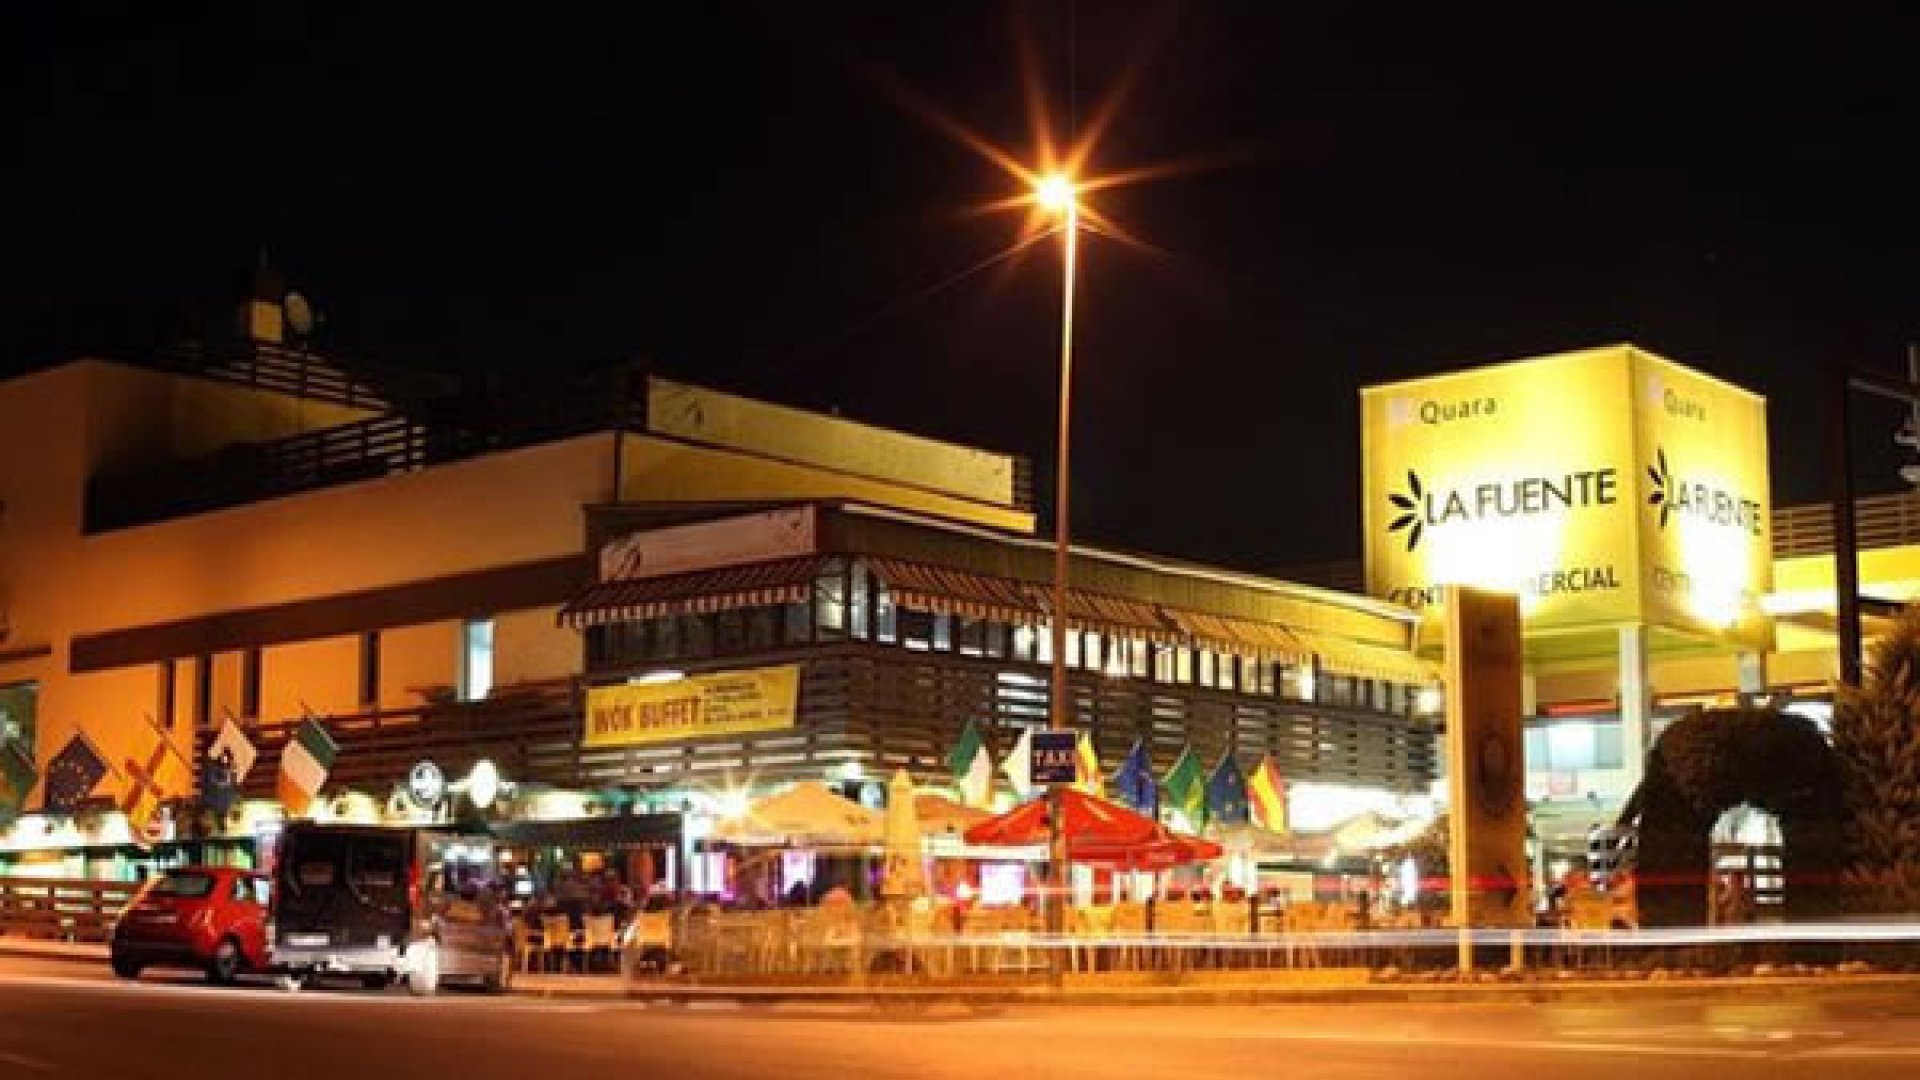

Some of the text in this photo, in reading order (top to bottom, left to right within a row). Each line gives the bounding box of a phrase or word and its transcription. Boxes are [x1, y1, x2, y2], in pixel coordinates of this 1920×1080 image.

[1420, 398, 1497, 424] Quara
[1426, 468, 1617, 525] LA FUENTE
[1695, 484, 1762, 537] FUENTE
[1537, 565, 1621, 596] ERCIAL
[638, 695, 701, 728] BUFFET
[1033, 749, 1076, 768] TAXI
